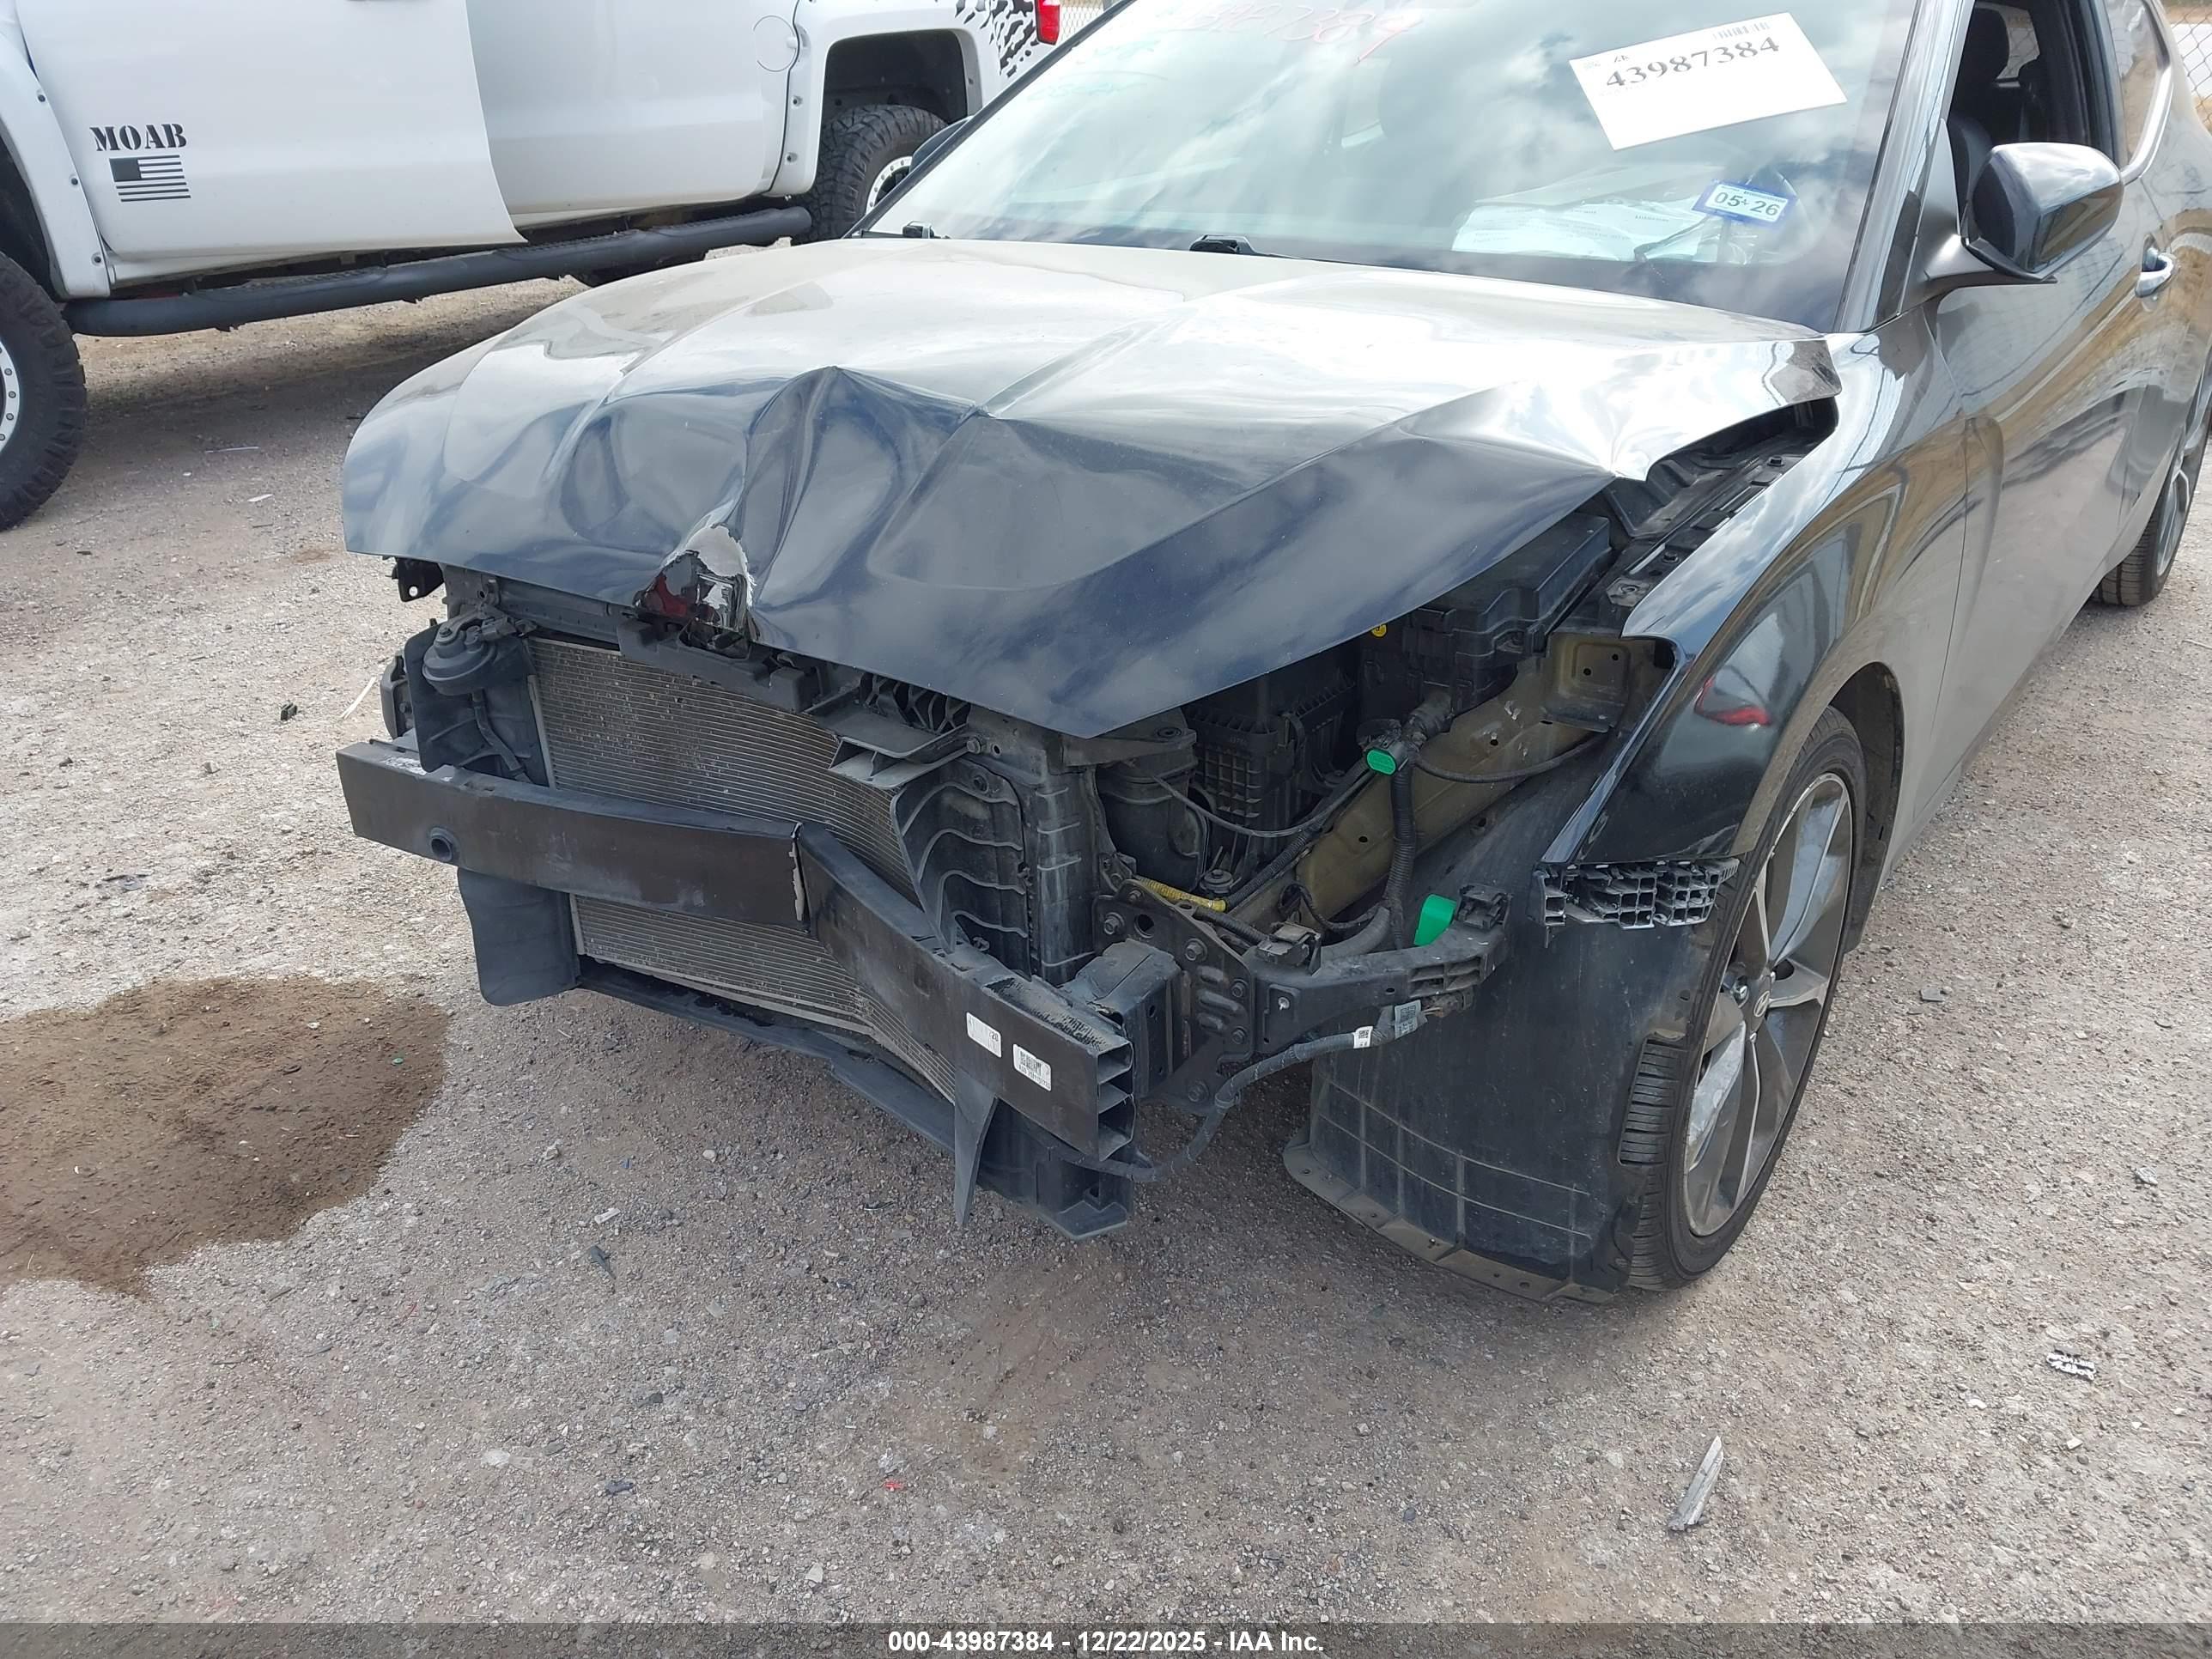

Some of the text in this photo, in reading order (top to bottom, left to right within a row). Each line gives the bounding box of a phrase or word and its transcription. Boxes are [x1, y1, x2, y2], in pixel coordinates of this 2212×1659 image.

[1607, 37, 1780, 87] 43987384
[89, 123, 187, 151] MOAB
[1714, 191, 1780, 216] 05 26
